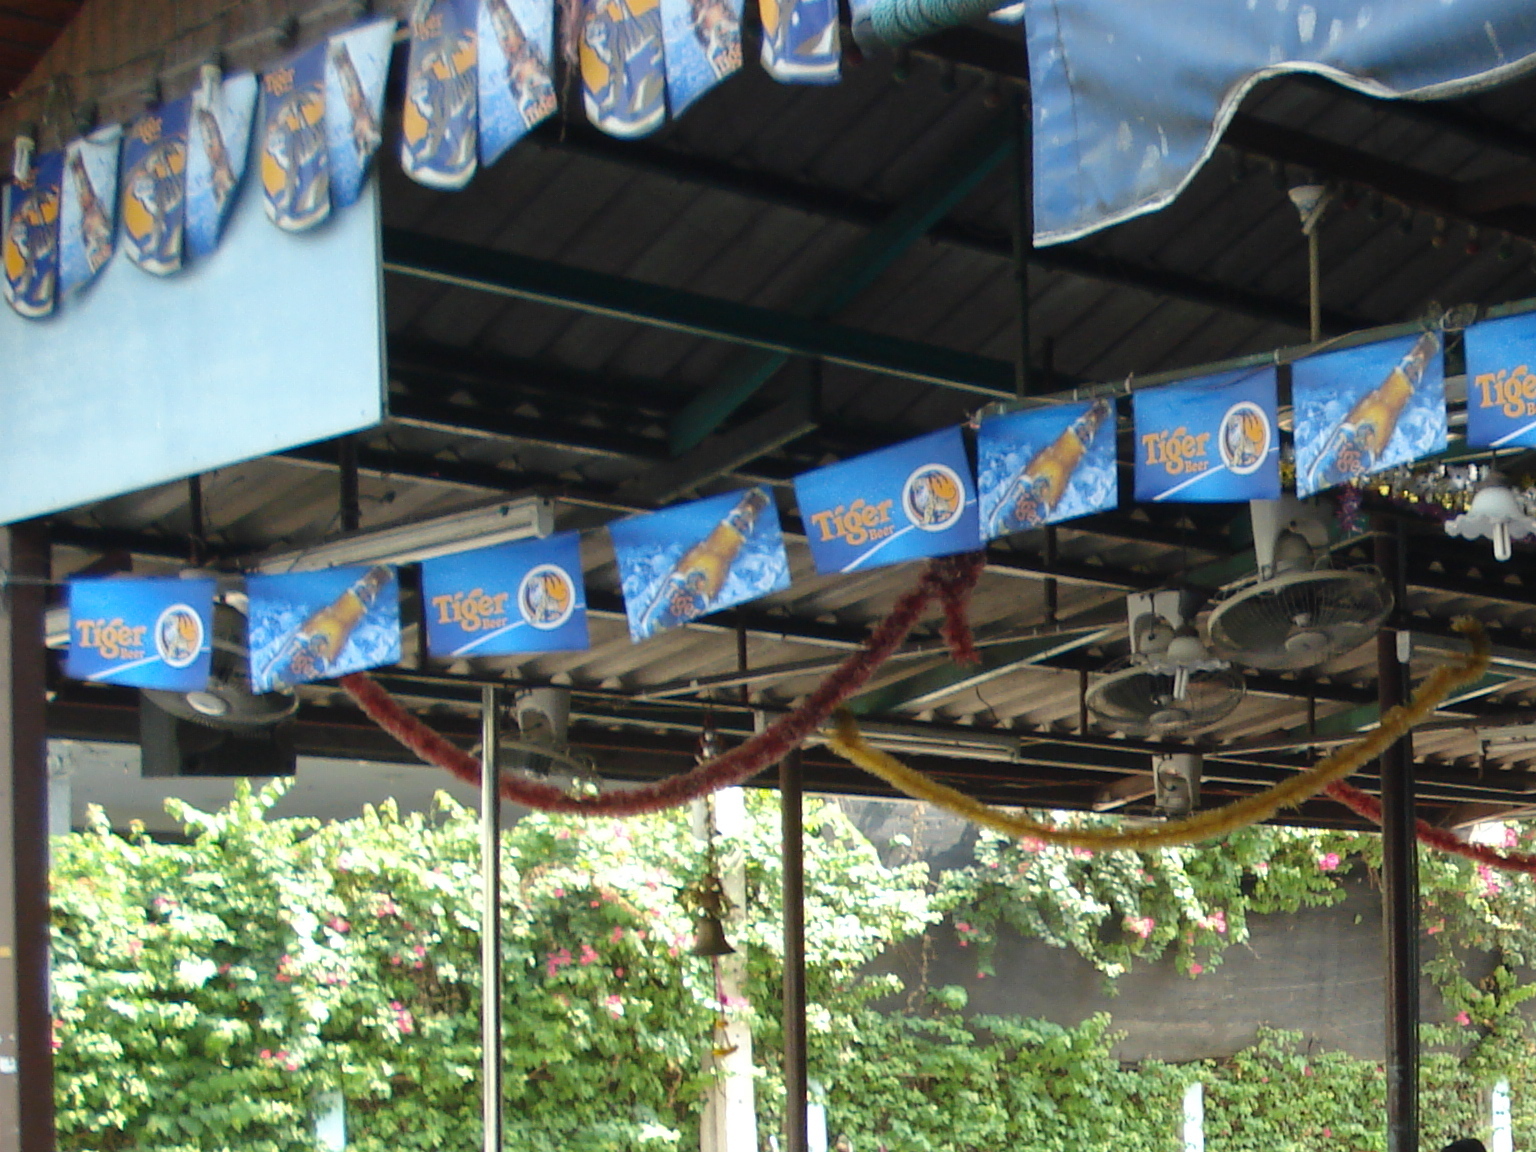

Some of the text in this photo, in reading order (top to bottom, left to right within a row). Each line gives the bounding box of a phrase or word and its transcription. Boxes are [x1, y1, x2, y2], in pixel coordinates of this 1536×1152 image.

[1142, 426, 1211, 475] Tiger
[1185, 457, 1210, 473] Beer
[811, 498, 894, 546] Tiger
[869, 523, 896, 542] Beer
[432, 588, 509, 632] Tiger
[482, 616, 508, 631] Beer
[75, 618, 147, 660] Tiger
[120, 645, 145, 660] Beer
